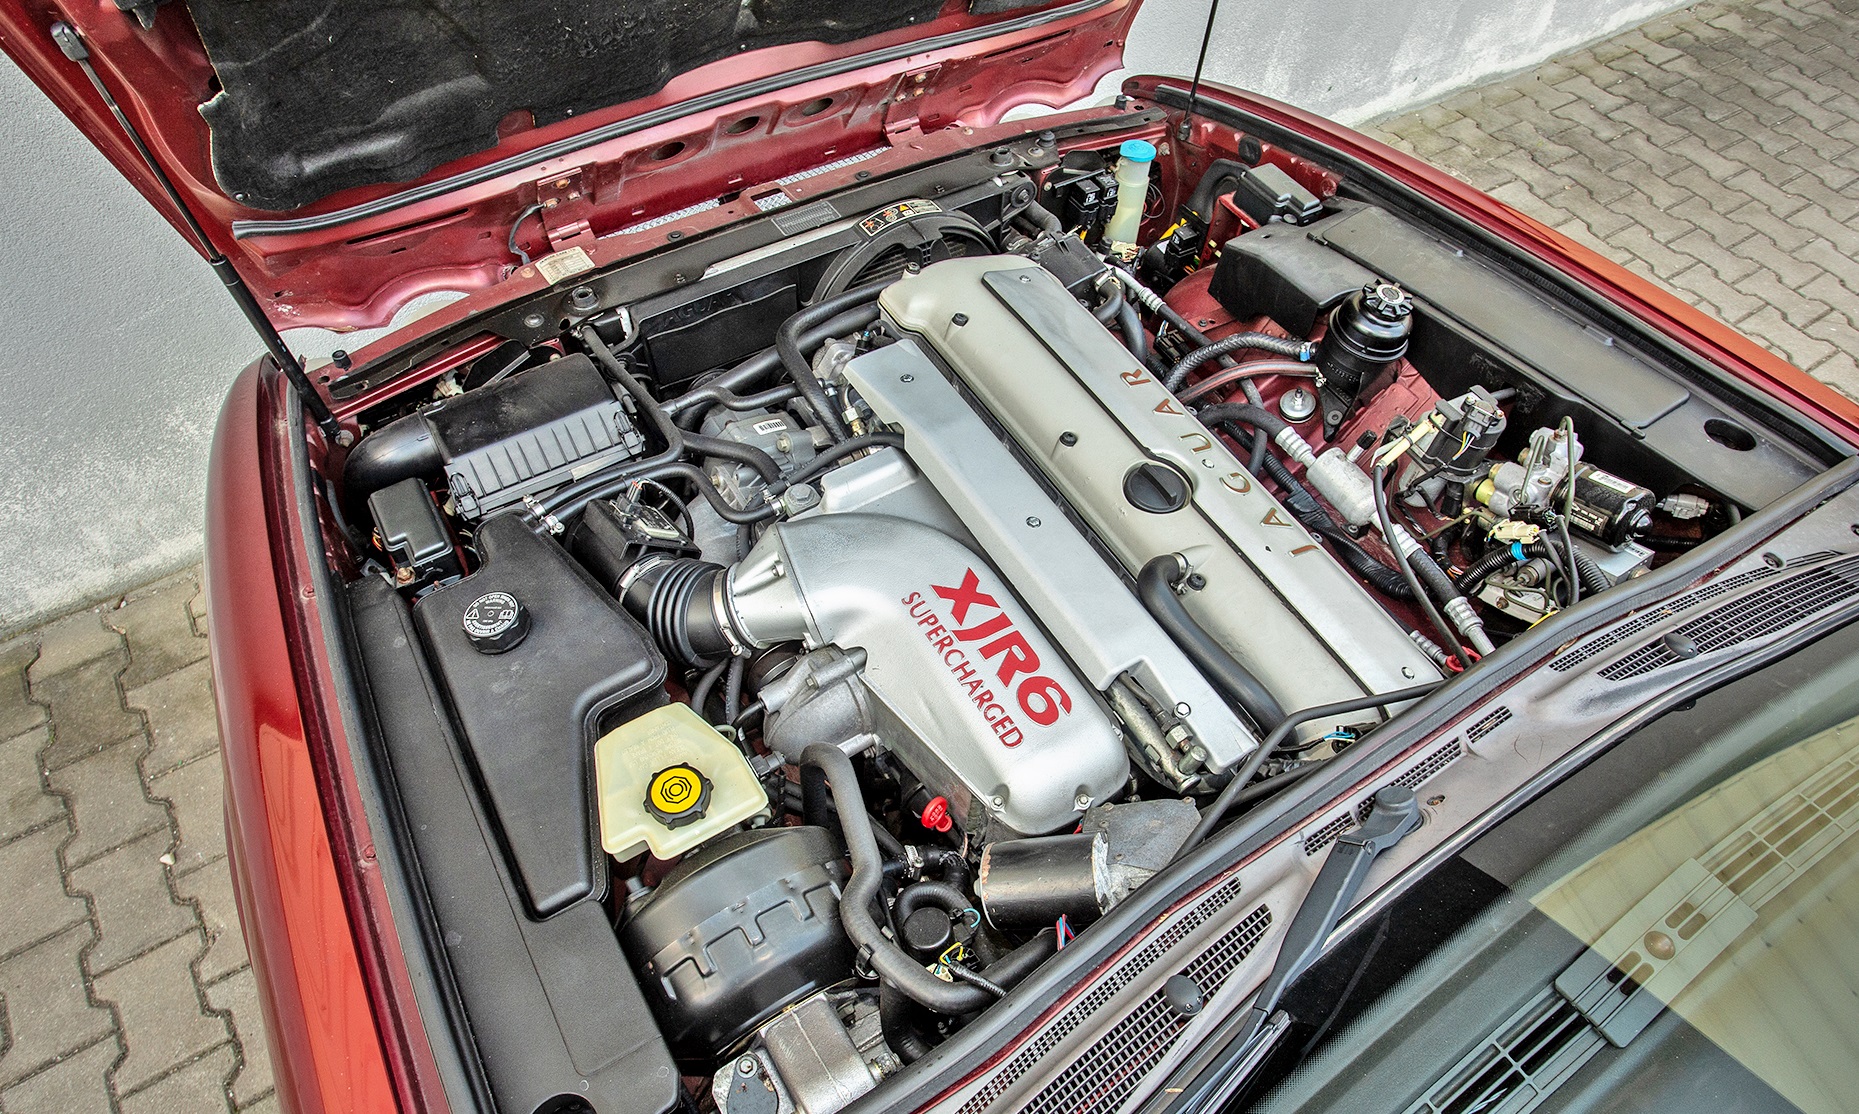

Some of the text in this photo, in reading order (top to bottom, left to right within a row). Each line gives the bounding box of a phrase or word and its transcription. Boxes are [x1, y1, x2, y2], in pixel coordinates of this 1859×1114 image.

[1120, 369, 1319, 557] JAGUAR
[900, 591, 1024, 749] SUPERCHARGED
[930, 566, 1073, 728] XJR6
